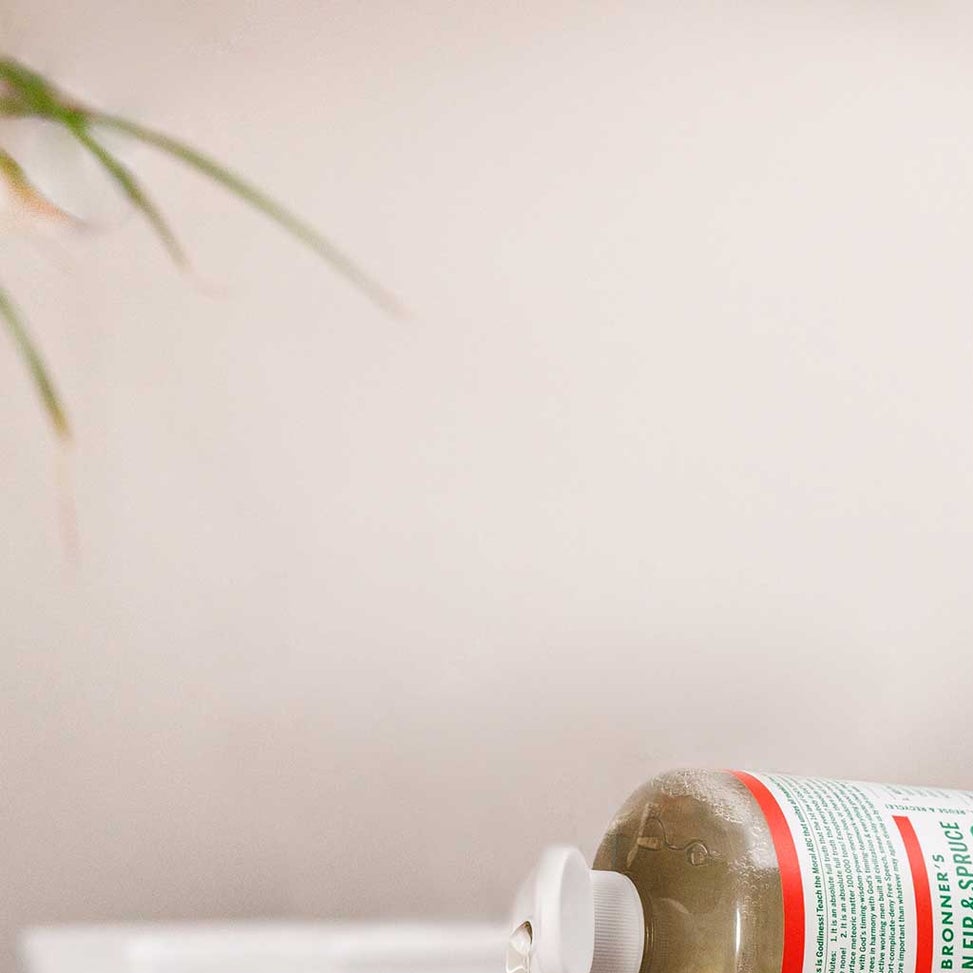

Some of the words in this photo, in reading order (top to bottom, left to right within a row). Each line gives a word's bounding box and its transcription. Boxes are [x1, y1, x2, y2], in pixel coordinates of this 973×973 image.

[798, 822, 810, 838] that
[810, 819, 821, 831] the
[821, 824, 833, 840] that
[803, 835, 815, 854] ABC
[814, 830, 826, 845] that
[818, 843, 830, 863] truth
[826, 838, 838, 857] truth
[864, 838, 880, 875] civilization
[807, 851, 819, 875] Moral
[823, 862, 833, 876] full
[831, 856, 841, 870] full
[890, 856, 901, 873] may
[812, 874, 821, 889] the
[834, 868, 846, 902] absolute
[864, 874, 874, 895] God's
[873, 874, 882, 885] all
[891, 872, 904, 905] whatever
[825, 875, 836, 908] absolute
[874, 884, 884, 902] built
[884, 881, 893, 899] Free
[814, 888, 823, 912] Teach
[840, 902, 846, 913] an
[847, 889, 856, 915] matter
[866, 894, 875, 912] with
[831, 908, 837, 918] an
[839, 913, 847, 921] is
[896, 905, 904, 923] than
[932, 854, 954, 970] BRONNER'S
[829, 919, 837, 927] is
[839, 921, 847, 929] It
[848, 914, 856, 950] meteoric
[868, 912, 877, 946] harmony
[815, 913, 824, 958] Godliness!
[829, 934, 837, 942] 1.
[839, 930, 847, 938] 2.
[858, 929, 866, 953] God's
[878, 920, 887, 951] working
[896, 923, 906, 961] important
[837, 946, 846, 969] none!
[868, 946, 875, 955] in
[814, 958, 822, 966] is
[857, 953, 865, 971] with
